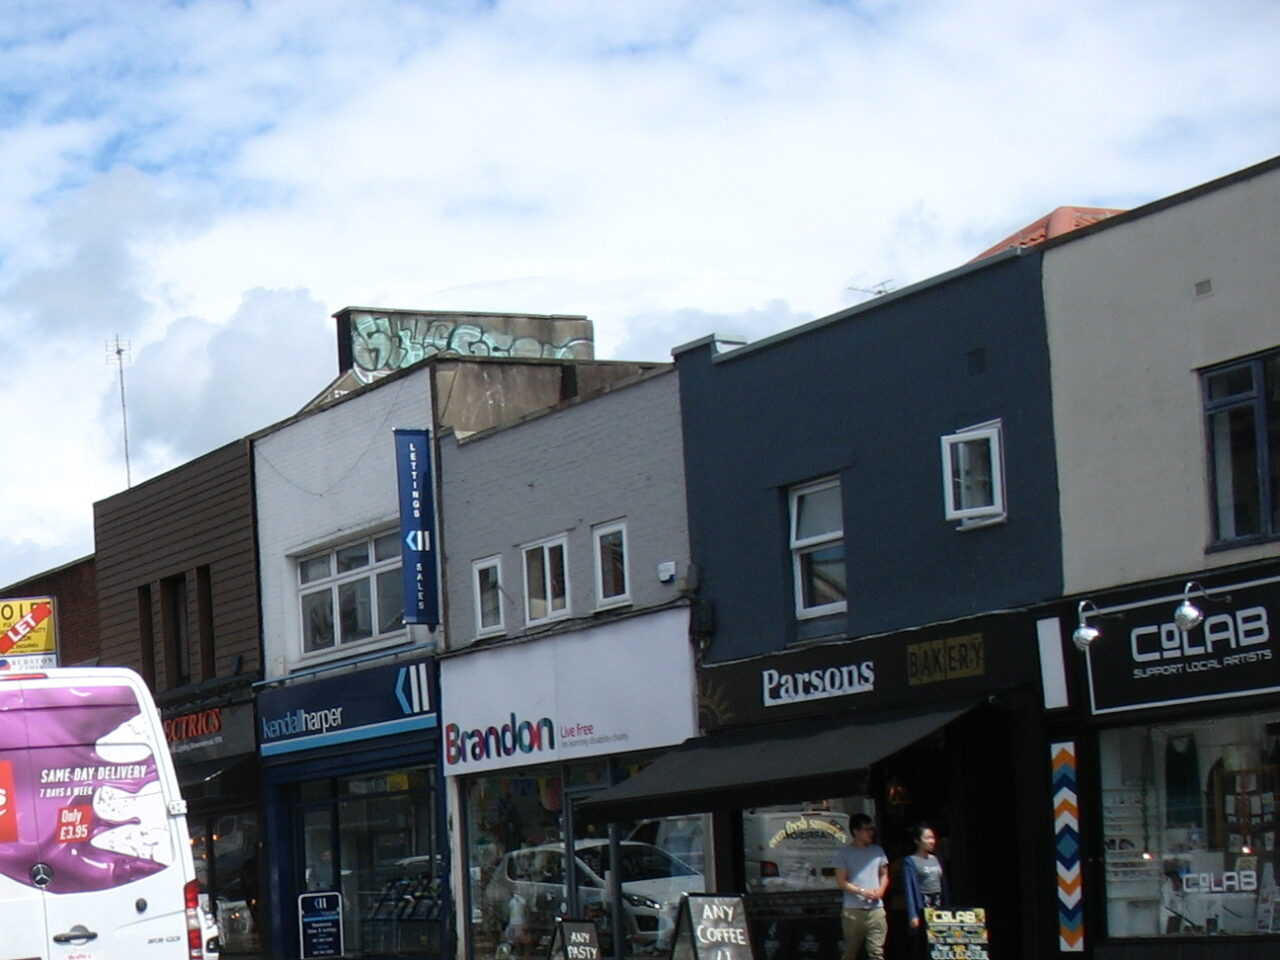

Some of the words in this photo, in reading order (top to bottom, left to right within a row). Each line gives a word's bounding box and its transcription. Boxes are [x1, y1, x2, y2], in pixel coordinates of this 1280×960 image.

[409, 443, 421, 518] LETTINGS
[416, 563, 424, 610] SALES
[7, 613, 36, 642] LET
[909, 641, 983, 678] BAKERY
[1133, 664, 1183, 679] SUPPORT
[1185, 660, 1221, 672] LOCAL
[1223, 649, 1272, 665] ARTISTS
[762, 661, 875, 700] Parsons
[445, 712, 555, 765] Brandon
[97, 765, 147, 780] DELIVERY
[46, 788, 64, 798] DAYS
[73, 786, 94, 796] WEEK
[62, 808, 82, 825] Only
[60, 824, 88, 840] £3.95
[702, 904, 734, 922] ANY
[570, 932, 590, 942] ANY
[697, 925, 747, 945] COFFEE
[567, 946, 598, 960] PASTY
